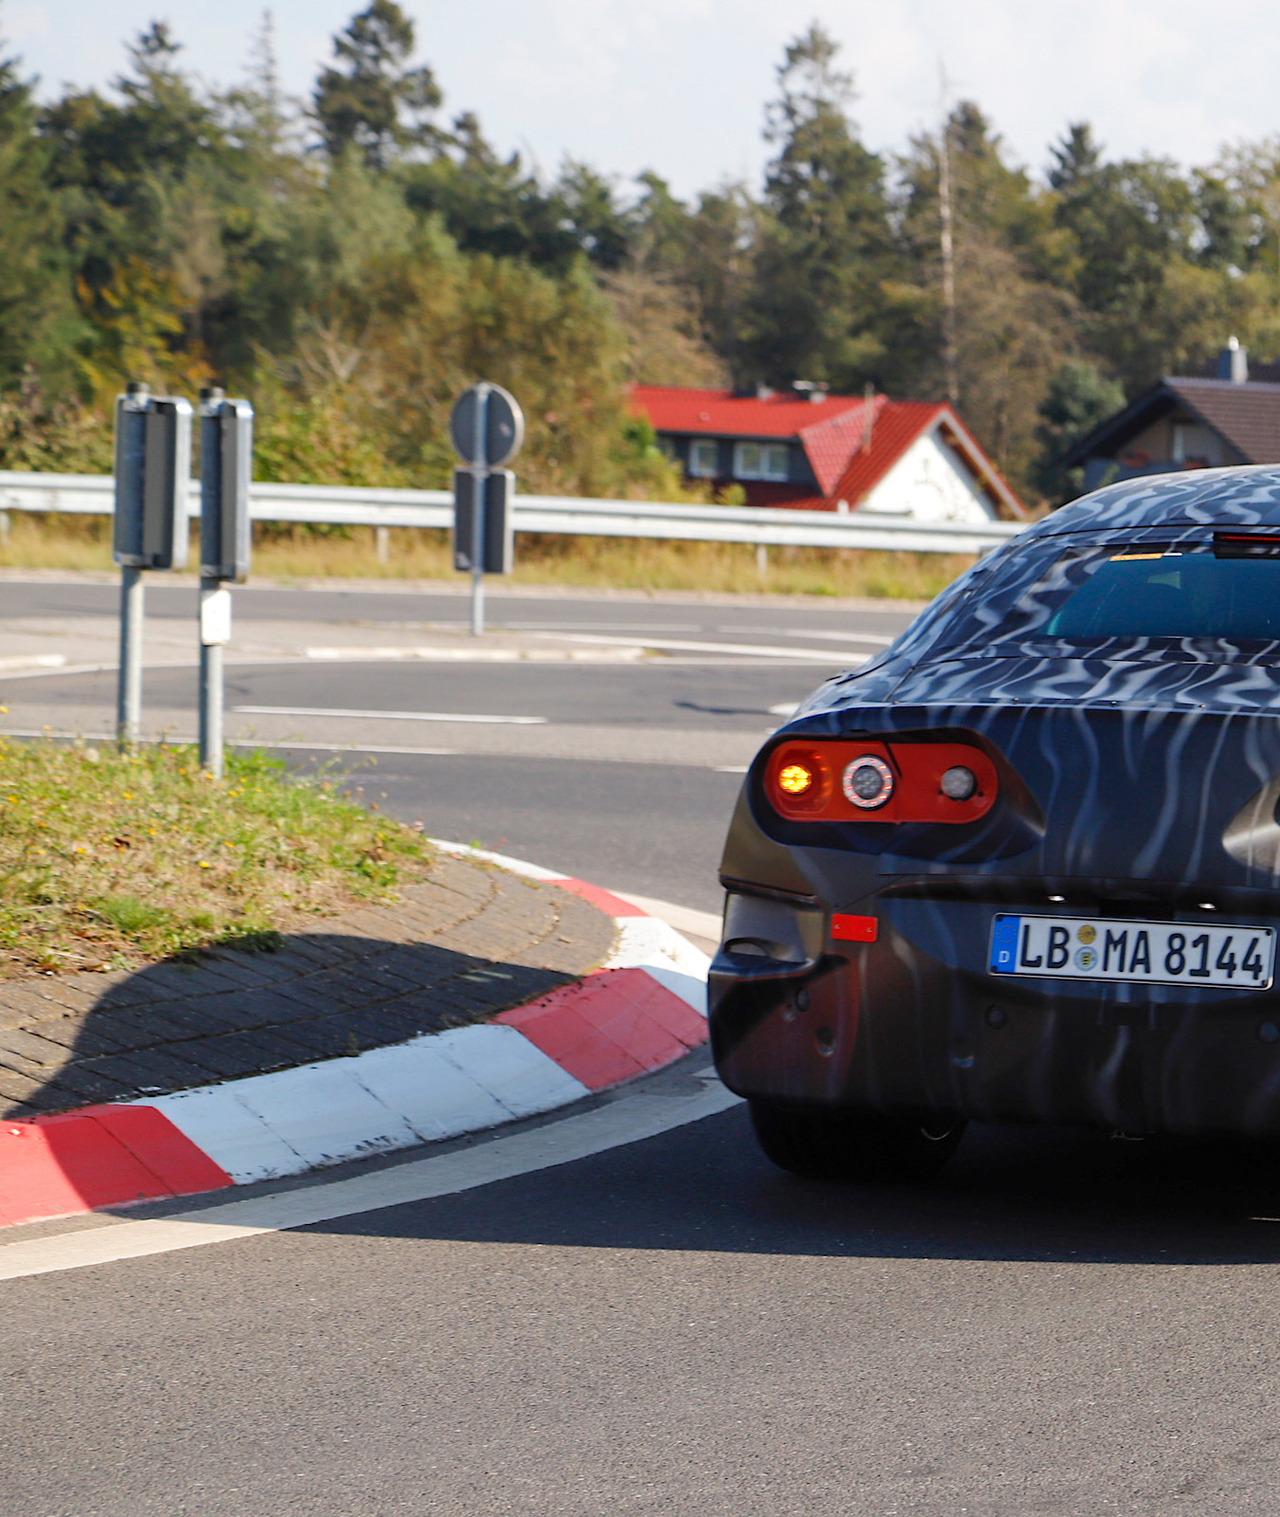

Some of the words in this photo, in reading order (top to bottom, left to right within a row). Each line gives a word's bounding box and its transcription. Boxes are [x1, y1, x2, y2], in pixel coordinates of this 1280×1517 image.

[999, 950, 1010, 963] D
[1020, 924, 1070, 969] LB
[1102, 929, 1151, 974] MA
[1164, 933, 1263, 980] 8144
